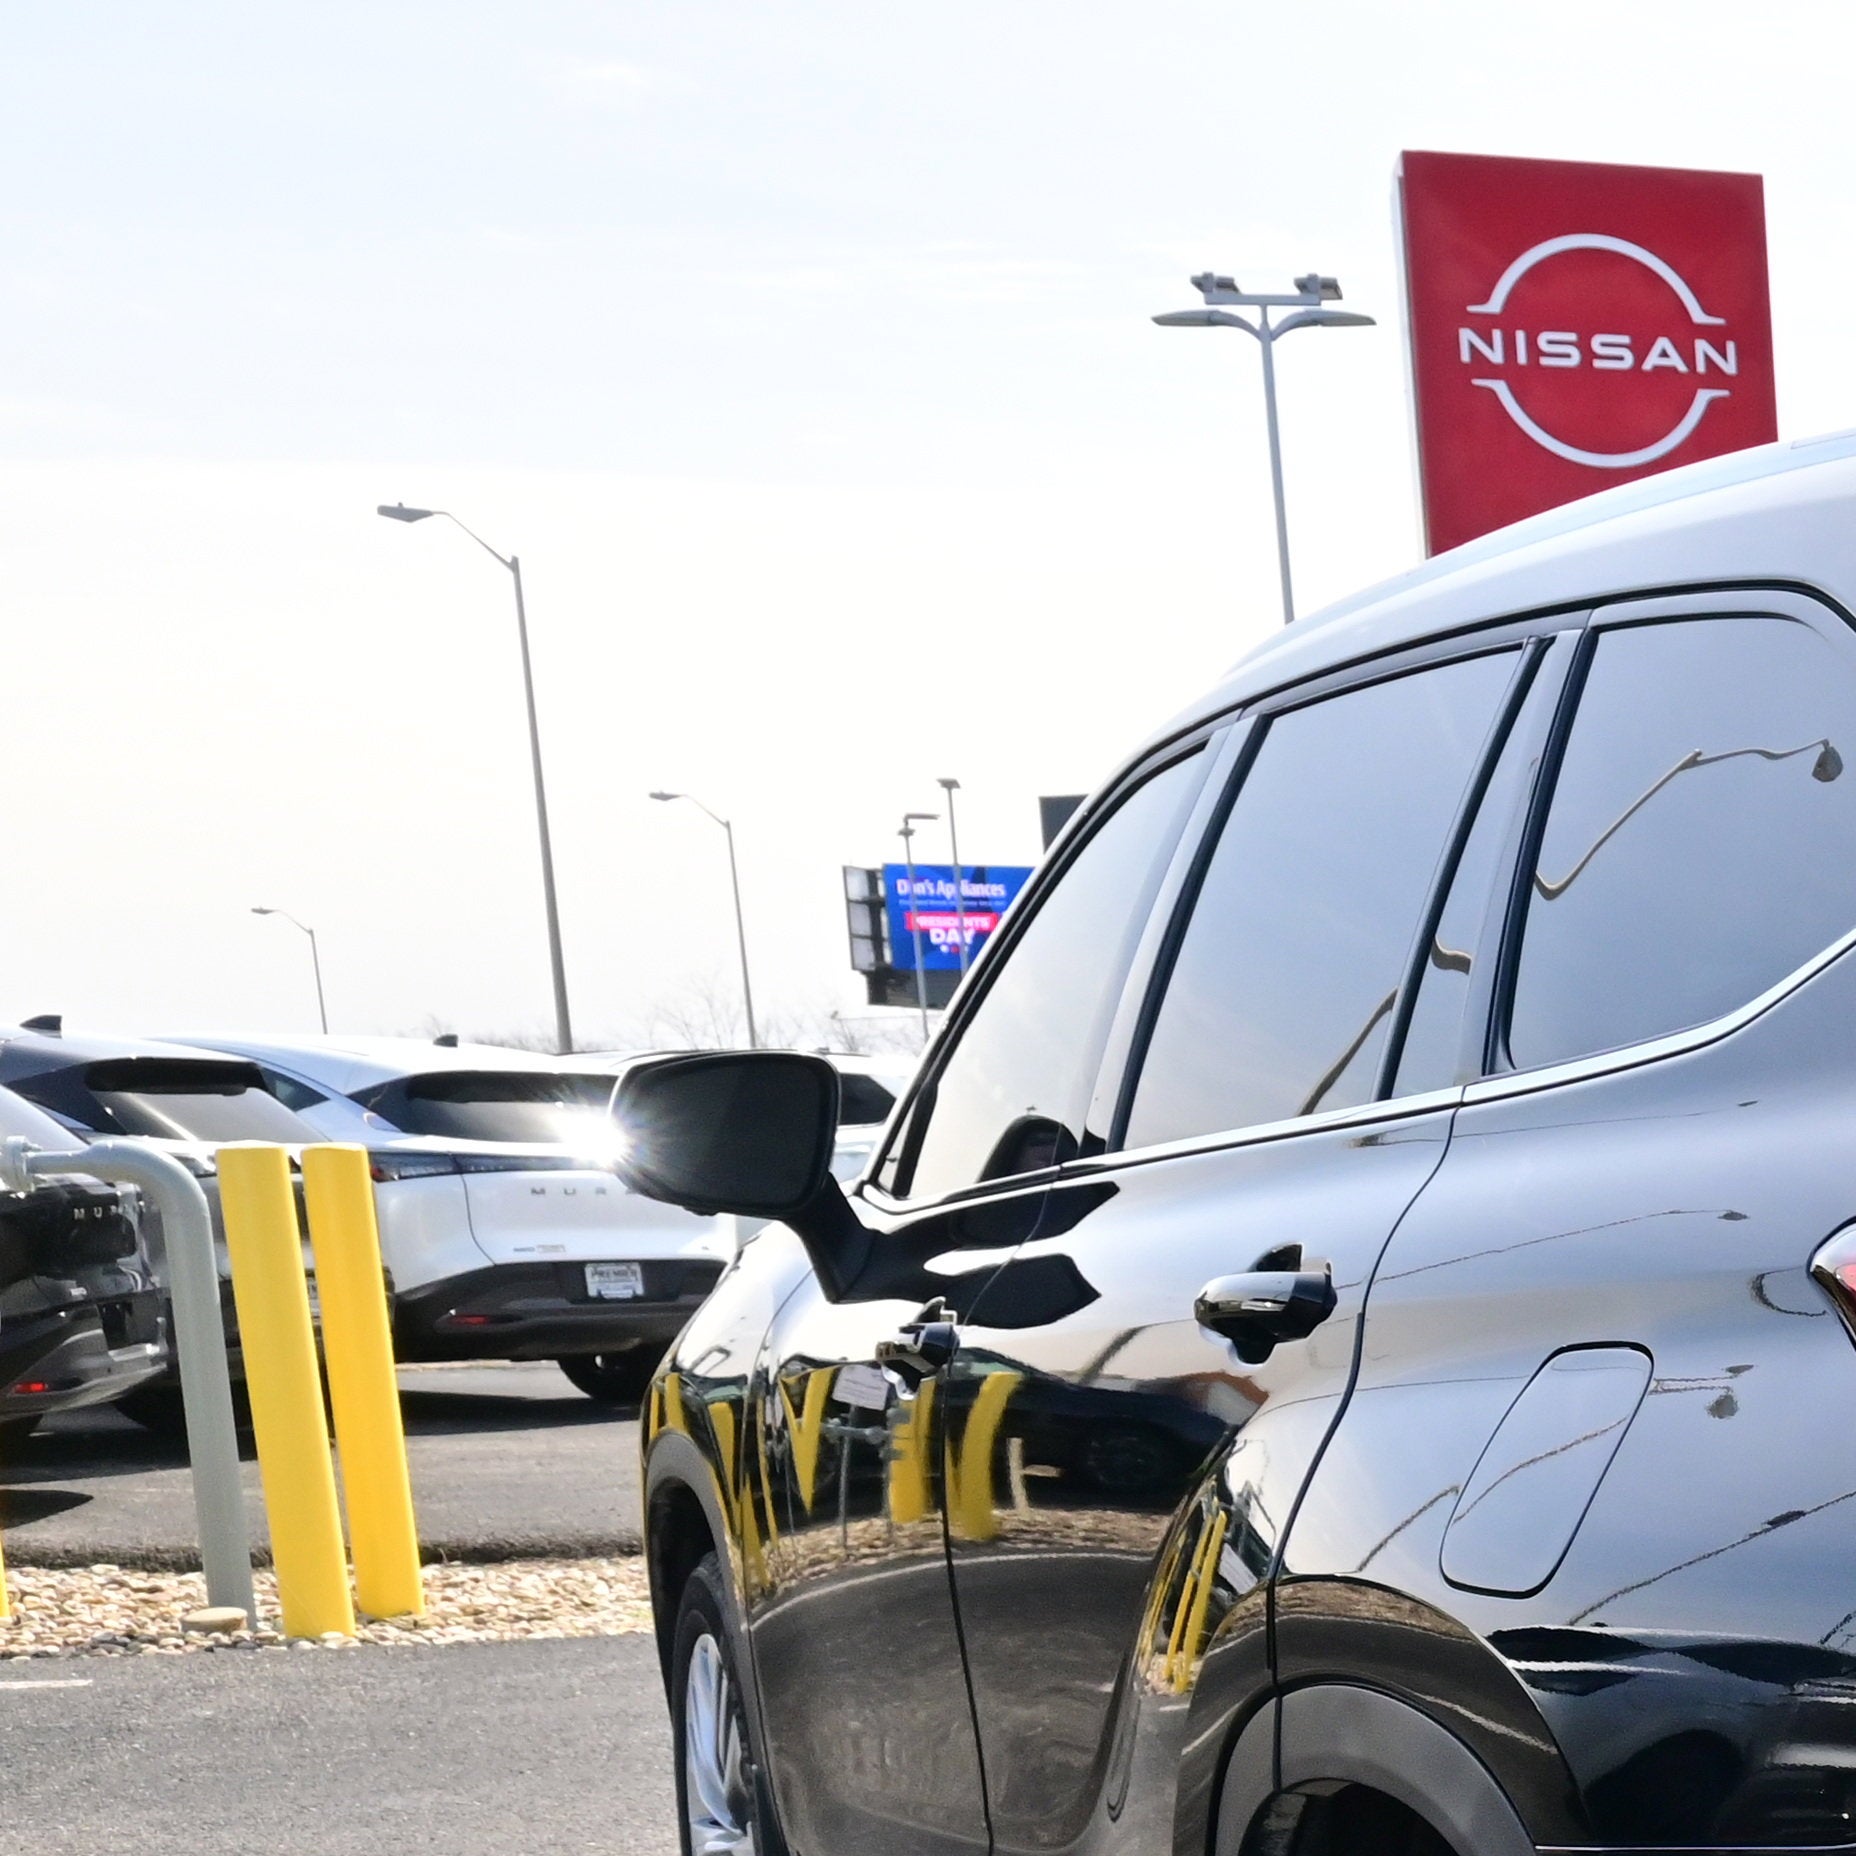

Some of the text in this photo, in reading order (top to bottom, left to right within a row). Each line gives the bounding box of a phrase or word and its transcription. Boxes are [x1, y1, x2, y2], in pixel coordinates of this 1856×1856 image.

[1458, 327, 1738, 375] NISSAN
[896, 879, 1006, 899] Dn's Apliances
[930, 928, 976, 945] DAY
